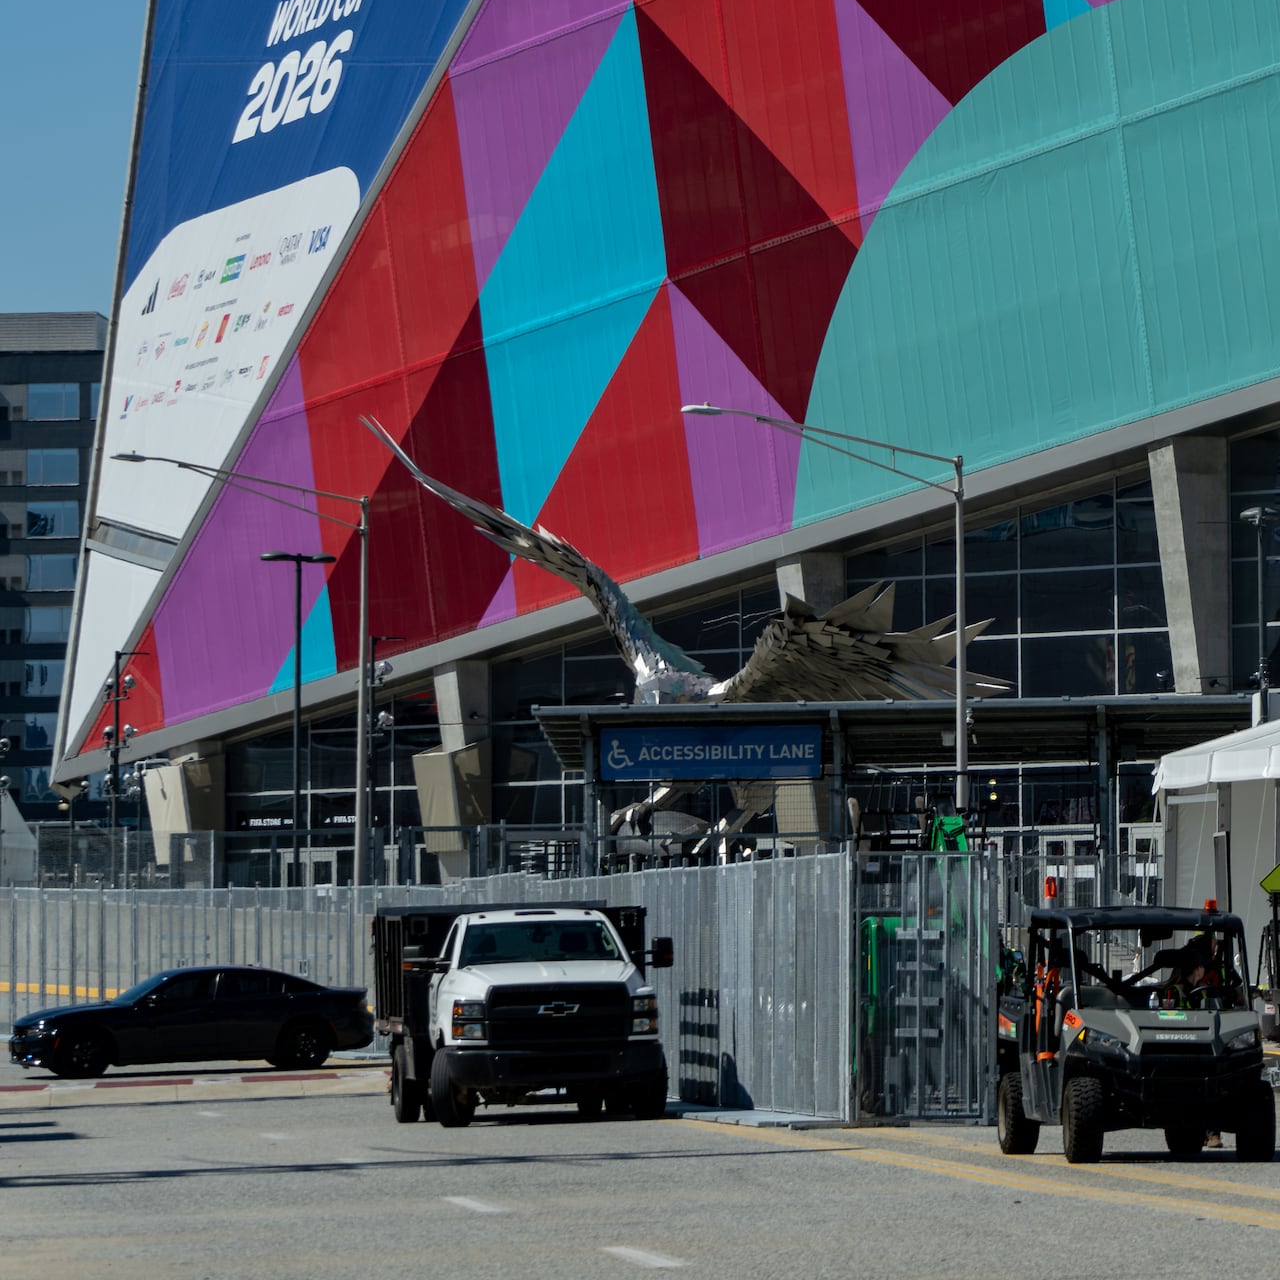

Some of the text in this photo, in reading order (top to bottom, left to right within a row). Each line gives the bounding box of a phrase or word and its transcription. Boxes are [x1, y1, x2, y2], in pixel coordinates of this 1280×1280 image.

[231, 29, 354, 145] 2026
[308, 224, 332, 255] VISA
[638, 744, 815, 761] ACCESSIBILITY LANE
